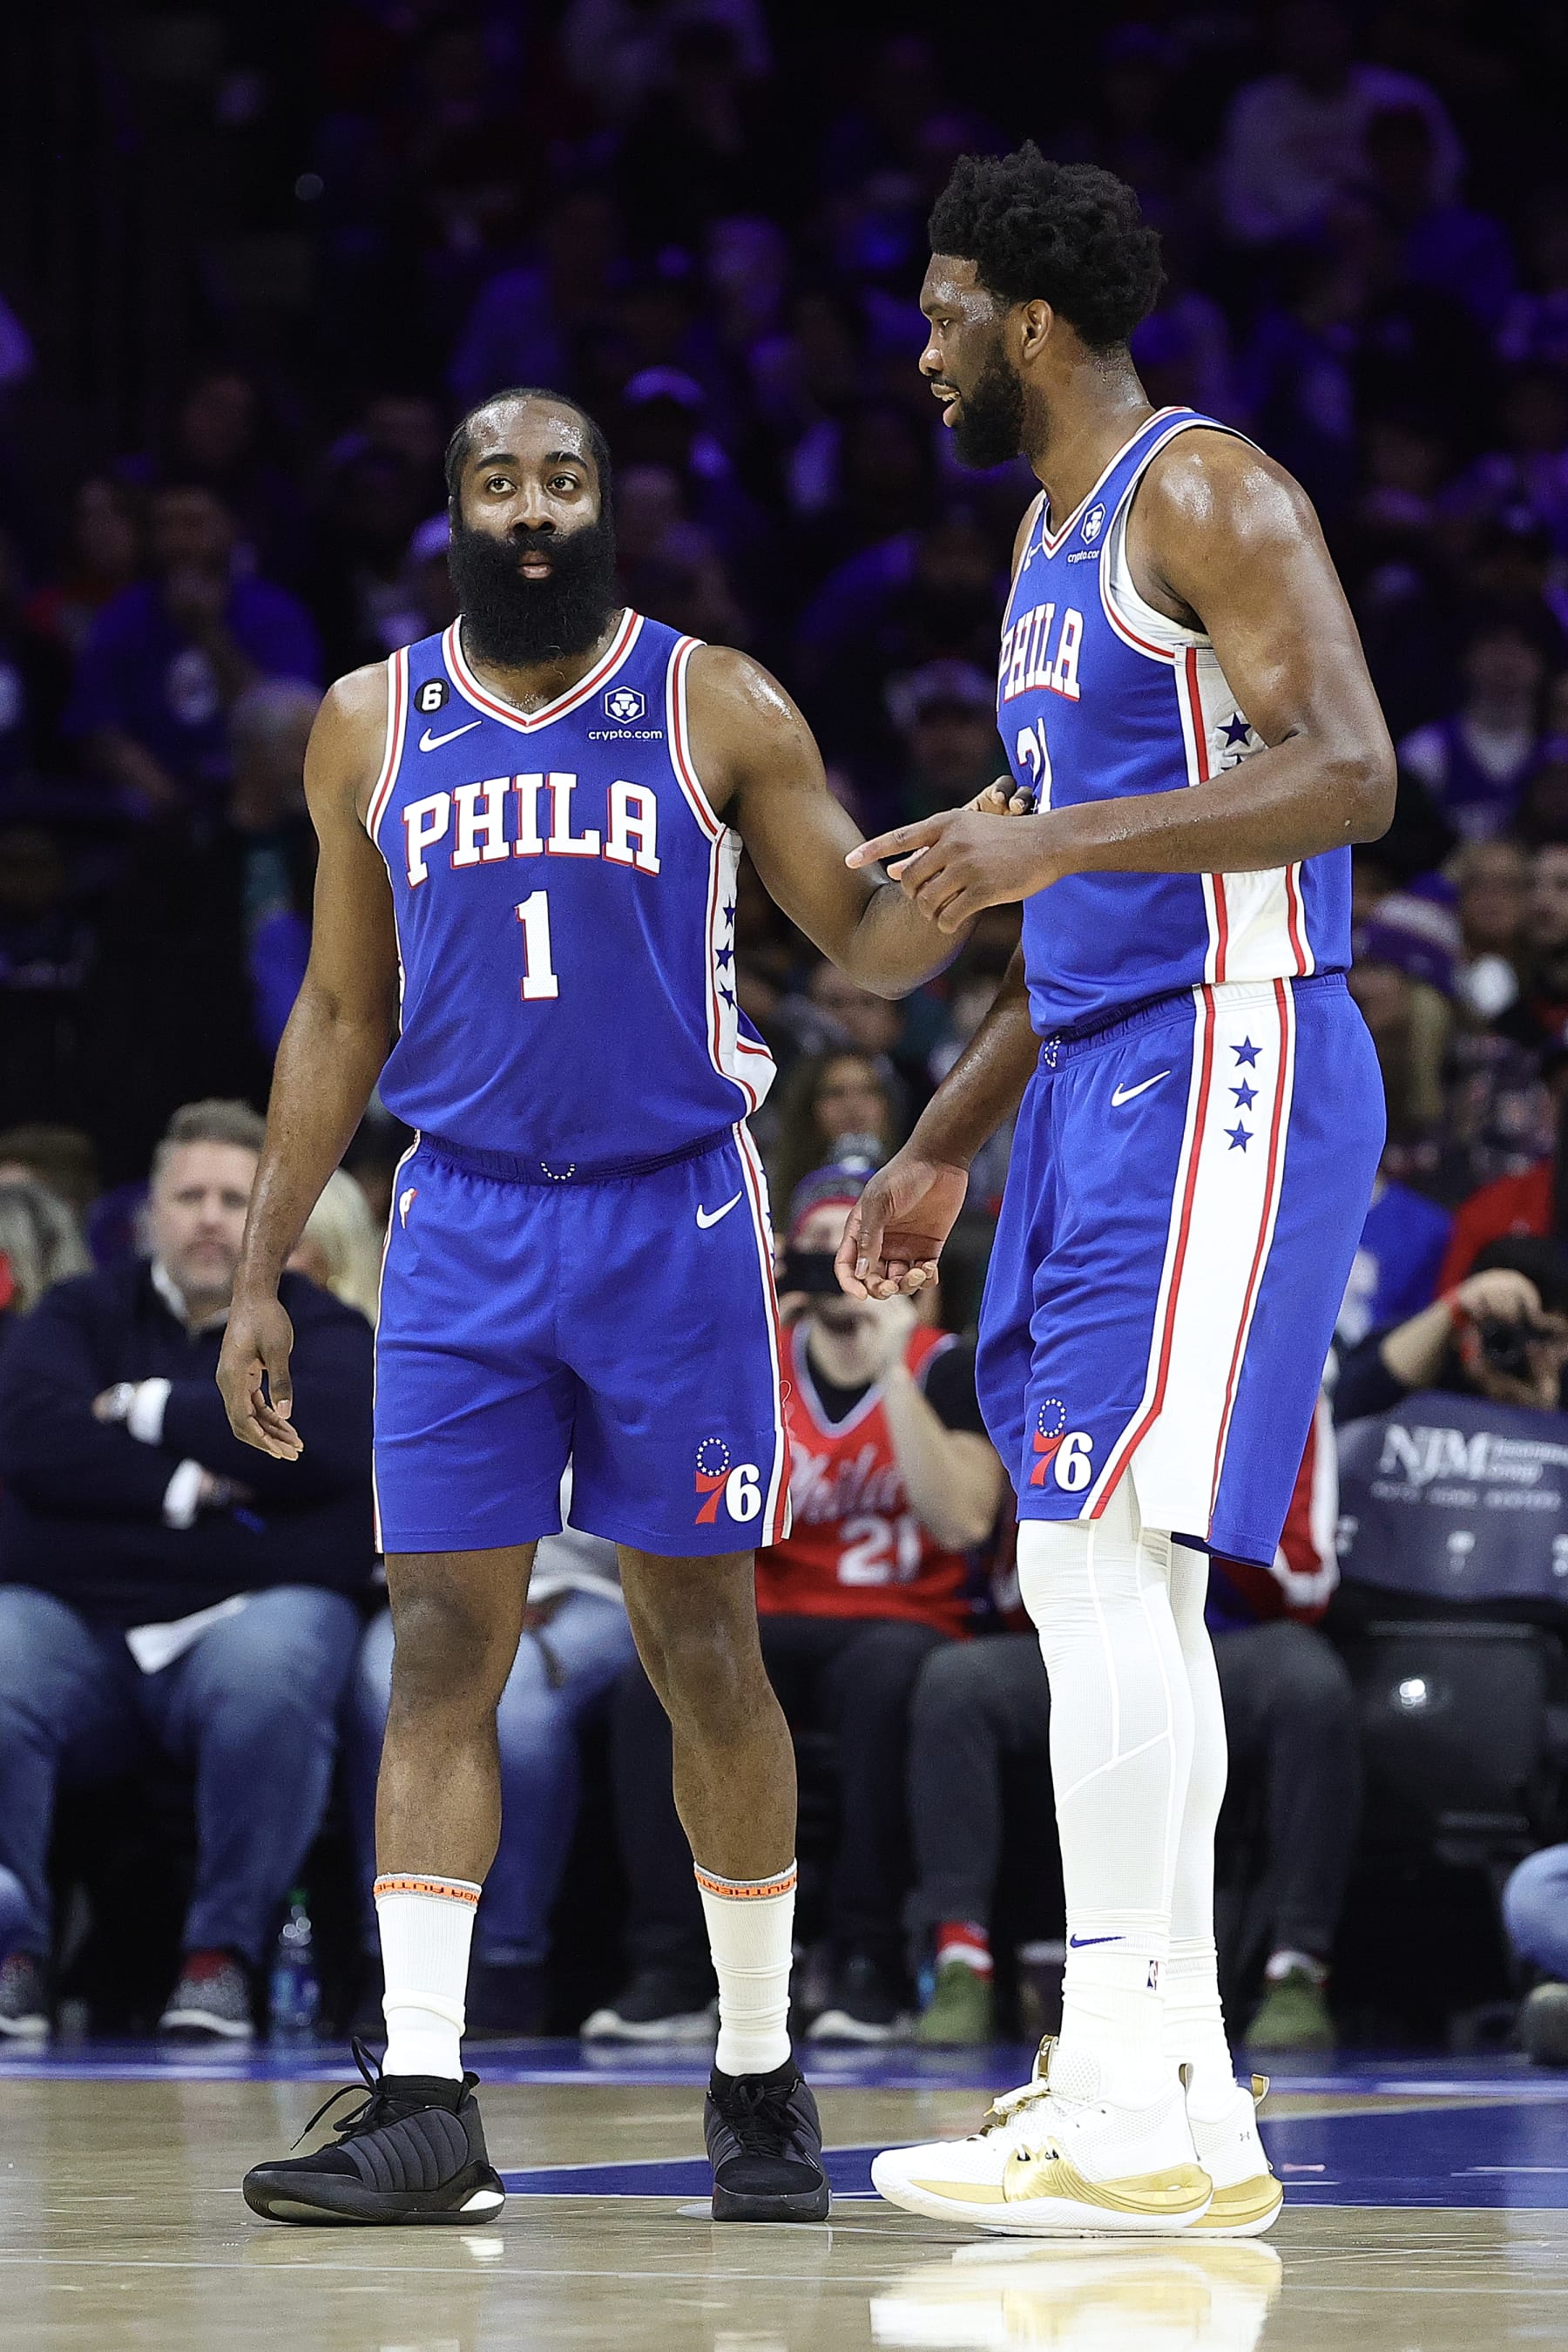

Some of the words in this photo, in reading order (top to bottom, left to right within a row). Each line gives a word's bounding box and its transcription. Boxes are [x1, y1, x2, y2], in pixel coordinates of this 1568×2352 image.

[1000, 602, 1084, 703] PHILA
[422, 683, 443, 712] 6
[588, 728, 663, 741] crypto.com
[402, 772, 661, 889] PHILA
[513, 890, 559, 1002] 1
[695, 1463, 762, 1525] 76
[1031, 1430, 1094, 1493] 76
[837, 1516, 923, 1587] 21
